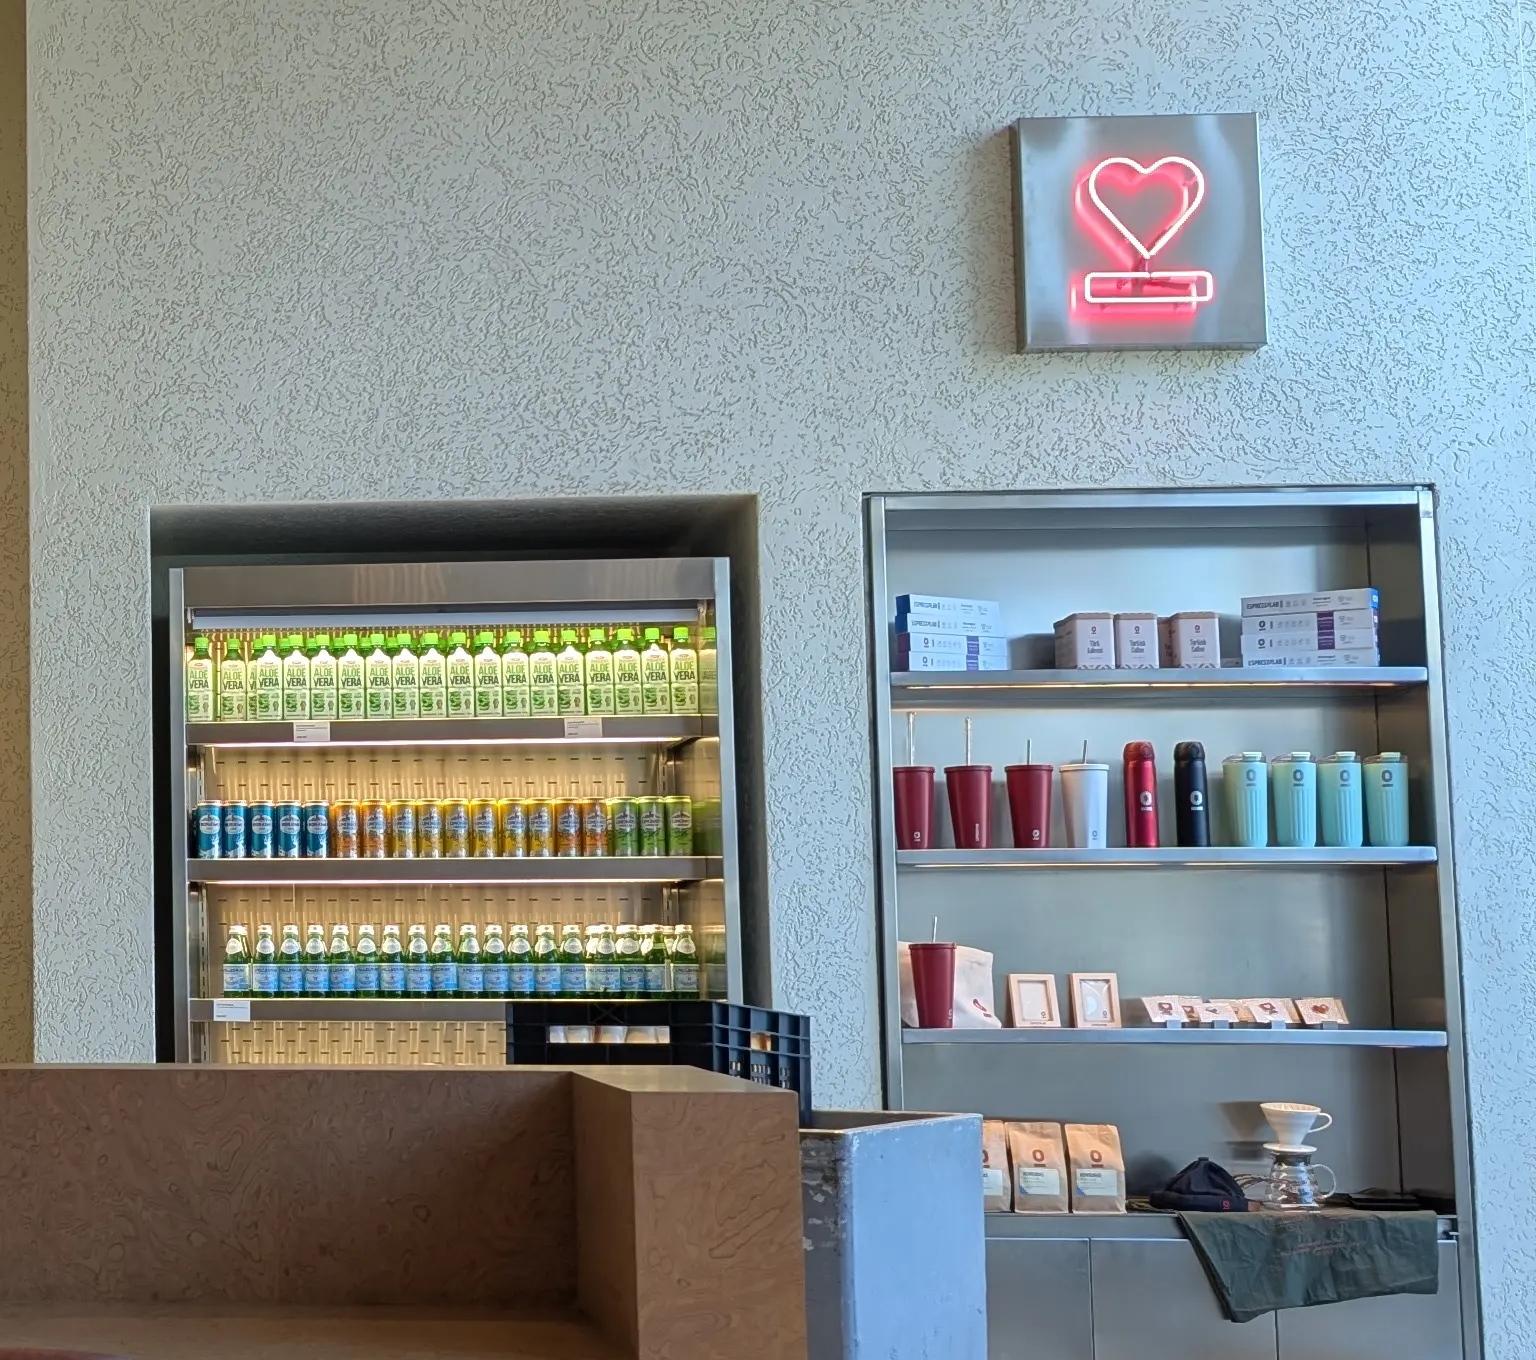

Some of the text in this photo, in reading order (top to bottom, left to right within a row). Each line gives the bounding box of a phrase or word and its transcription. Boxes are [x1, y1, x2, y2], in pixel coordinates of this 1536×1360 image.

[450, 665, 470, 675] ALOE
[479, 665, 498, 675] ALOE
[505, 665, 525, 675] ALOE
[533, 665, 553, 675] ALOE
[559, 663, 579, 674] ALOE
[590, 663, 609, 673] ALOE
[617, 662, 638, 673] ALOE
[645, 662, 665, 672] ALOE
[674, 661, 694, 671] ALOE
[189, 669, 208, 680] ALOE
[223, 671, 243, 681] ALOE
[259, 668, 279, 678] ALOE
[286, 668, 306, 678] ALOE
[313, 668, 333, 678] ALOE
[341, 668, 361, 678] ALOE
[369, 667, 389, 677] ALOE
[396, 667, 415, 677] ALOE
[422, 666, 442, 677] ALOE
[673, 671, 695, 681] VERA
[368, 677, 390, 687] VERA
[395, 677, 416, 686] VERA
[421, 676, 443, 686] VERA
[449, 675, 471, 686] VERA
[477, 675, 499, 685] VERA
[505, 674, 527, 684] VERA
[532, 674, 554, 684] VERA
[558, 674, 580, 684] VERA
[589, 673, 611, 683] VERA
[617, 673, 639, 682] VERA
[644, 672, 667, 682] VERA
[189, 679, 209, 689] VERA
[222, 680, 243, 690] VERA
[258, 678, 279, 688] VERA
[285, 678, 307, 687] VERA
[313, 678, 335, 687] VERA
[340, 678, 362, 688] VERA
